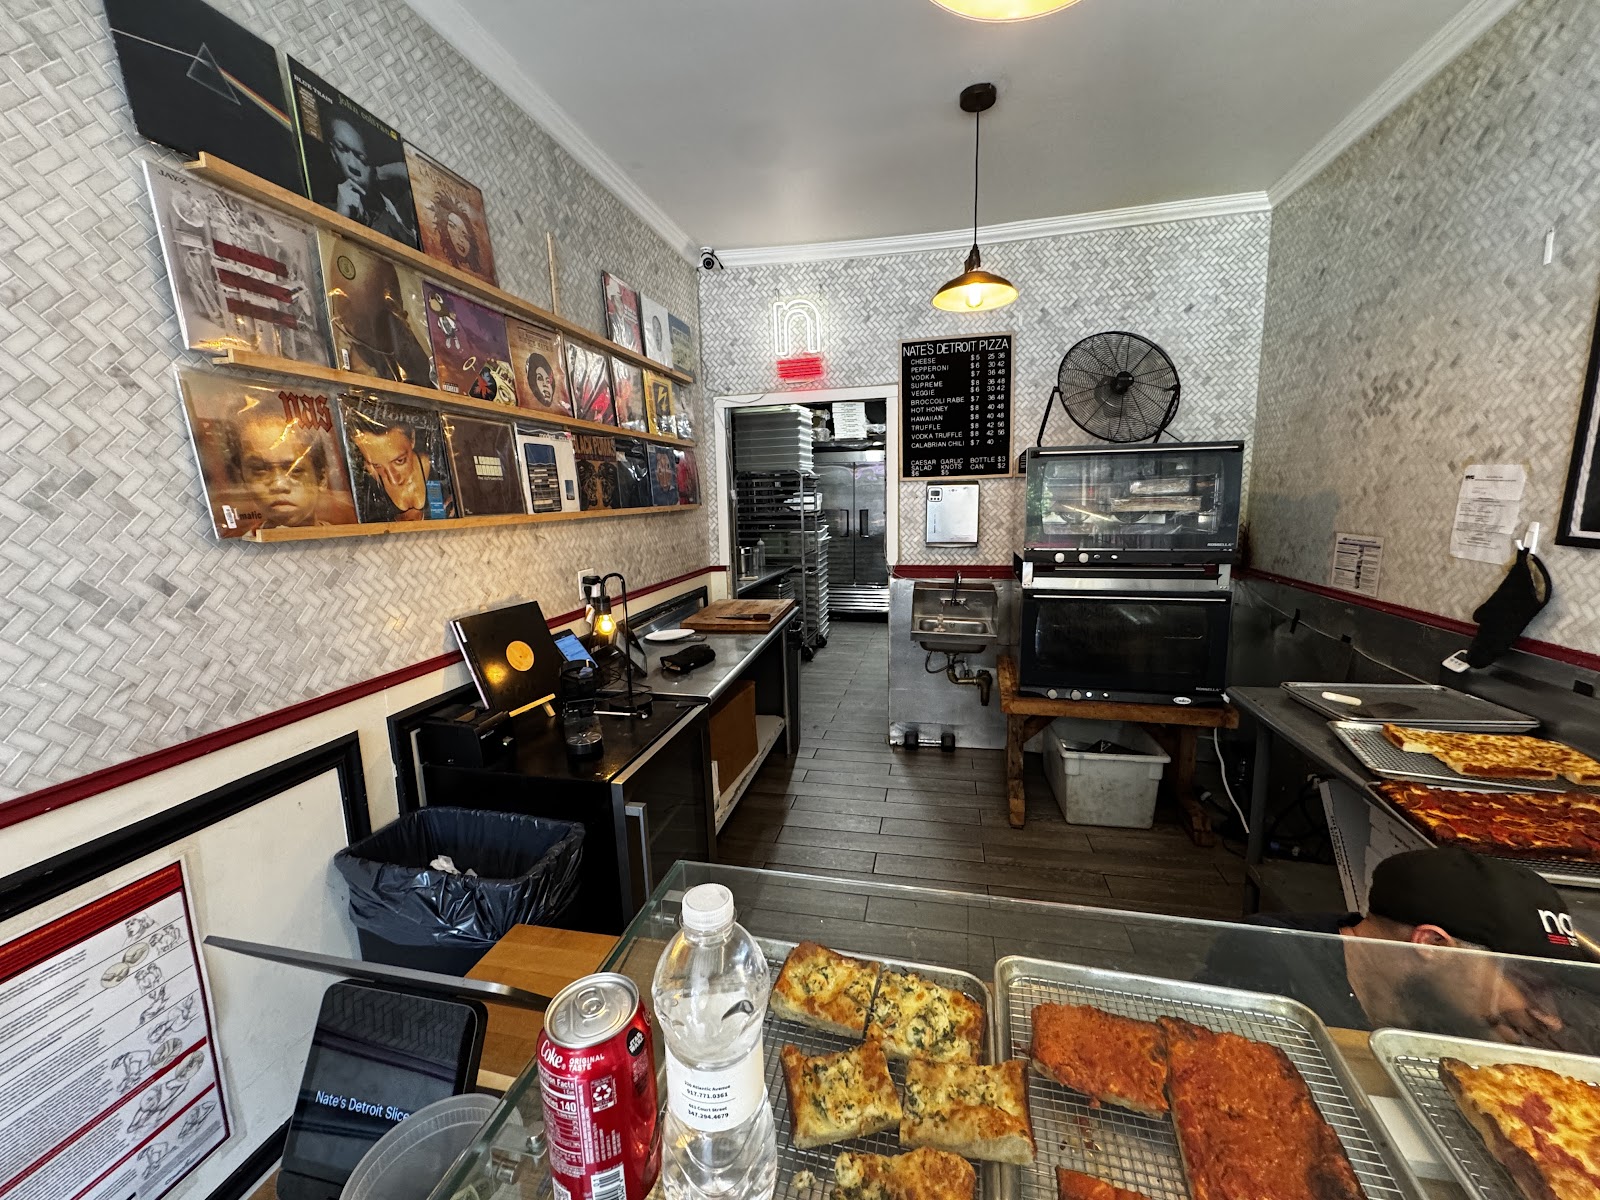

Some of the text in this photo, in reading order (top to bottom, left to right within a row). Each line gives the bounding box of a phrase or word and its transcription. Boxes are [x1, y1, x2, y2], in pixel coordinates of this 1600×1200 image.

[360, 111, 390, 135] coltran
[903, 339, 1008, 356] NATE'S DETROIT PIZZA
[541, 1040, 563, 1068] Coke
[569, 1053, 605, 1065] ORIGINAL
[569, 1063, 592, 1073] TASTE
[315, 1090, 347, 1109] Nate's
[348, 1097, 383, 1118] Detroit
[560, 1101, 576, 1112] 140
